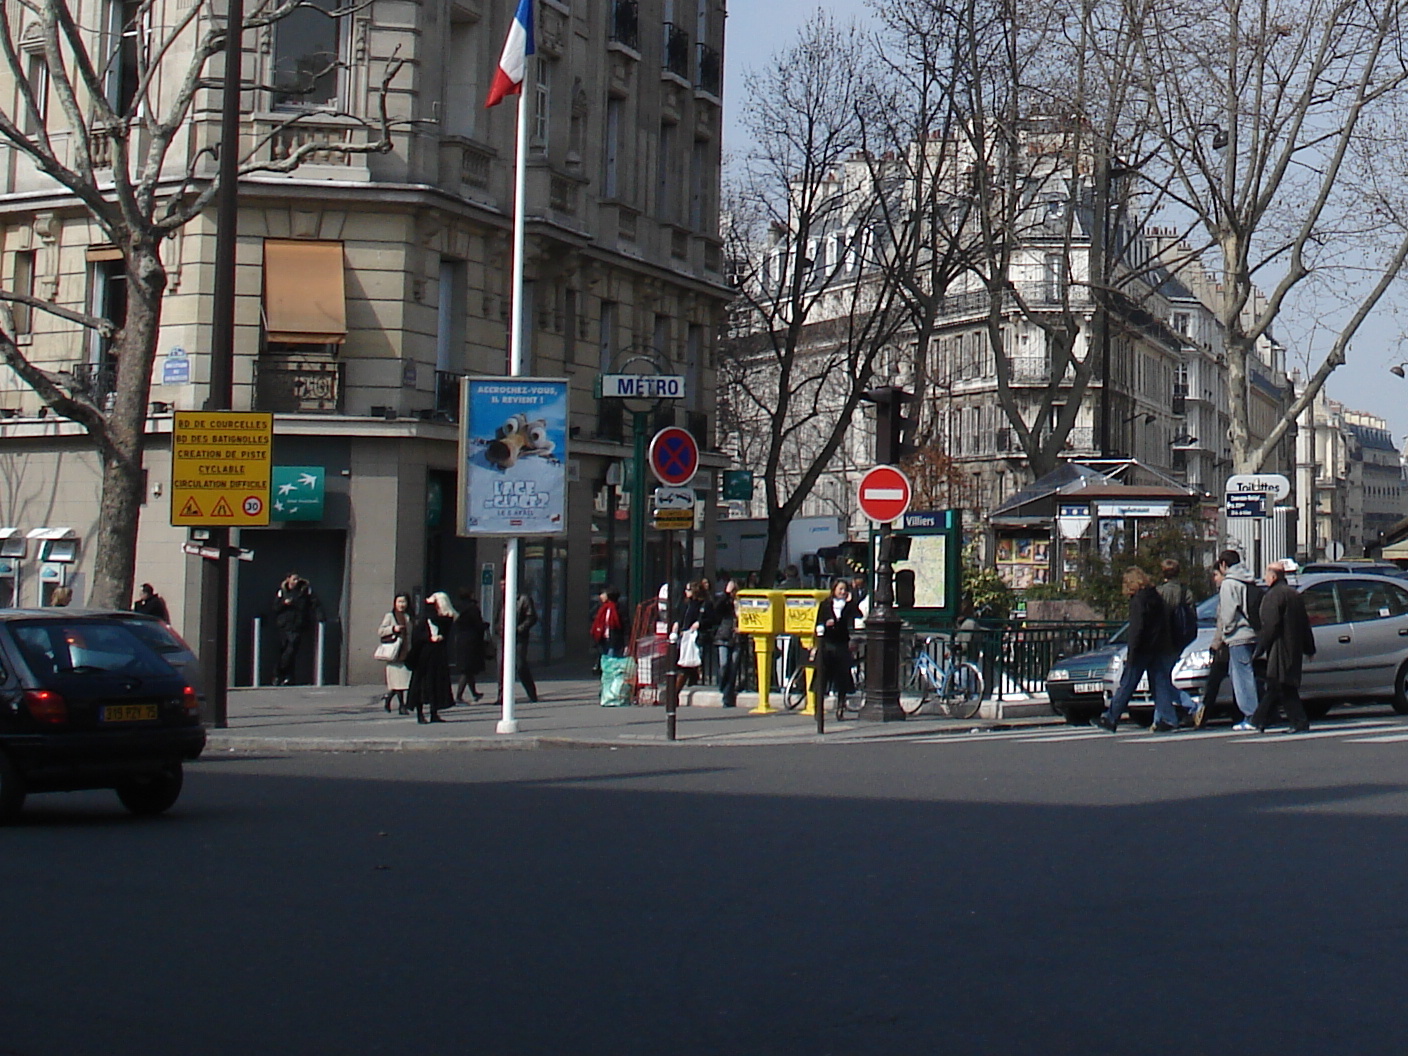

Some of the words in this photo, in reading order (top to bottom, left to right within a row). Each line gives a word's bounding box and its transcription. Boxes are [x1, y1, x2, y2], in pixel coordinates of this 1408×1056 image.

[502, 396, 538, 404] REVIENT
[178, 420, 190, 428] BD
[194, 420, 206, 428] DE
[210, 420, 267, 429] COURCELLES
[176, 435, 187, 443] BD
[191, 435, 208, 443] DES
[212, 435, 269, 444] BATIGNOLLES
[178, 450, 222, 458] CREATION
[226, 450, 236, 458] DE
[241, 450, 266, 458] PISTE
[198, 465, 245, 473] CYCLABLE
[174, 480, 226, 488] CIRCULATION
[230, 480, 267, 488] DIFFICILE
[246, 502, 258, 510] 30
[906, 516, 935, 527] Villiers
